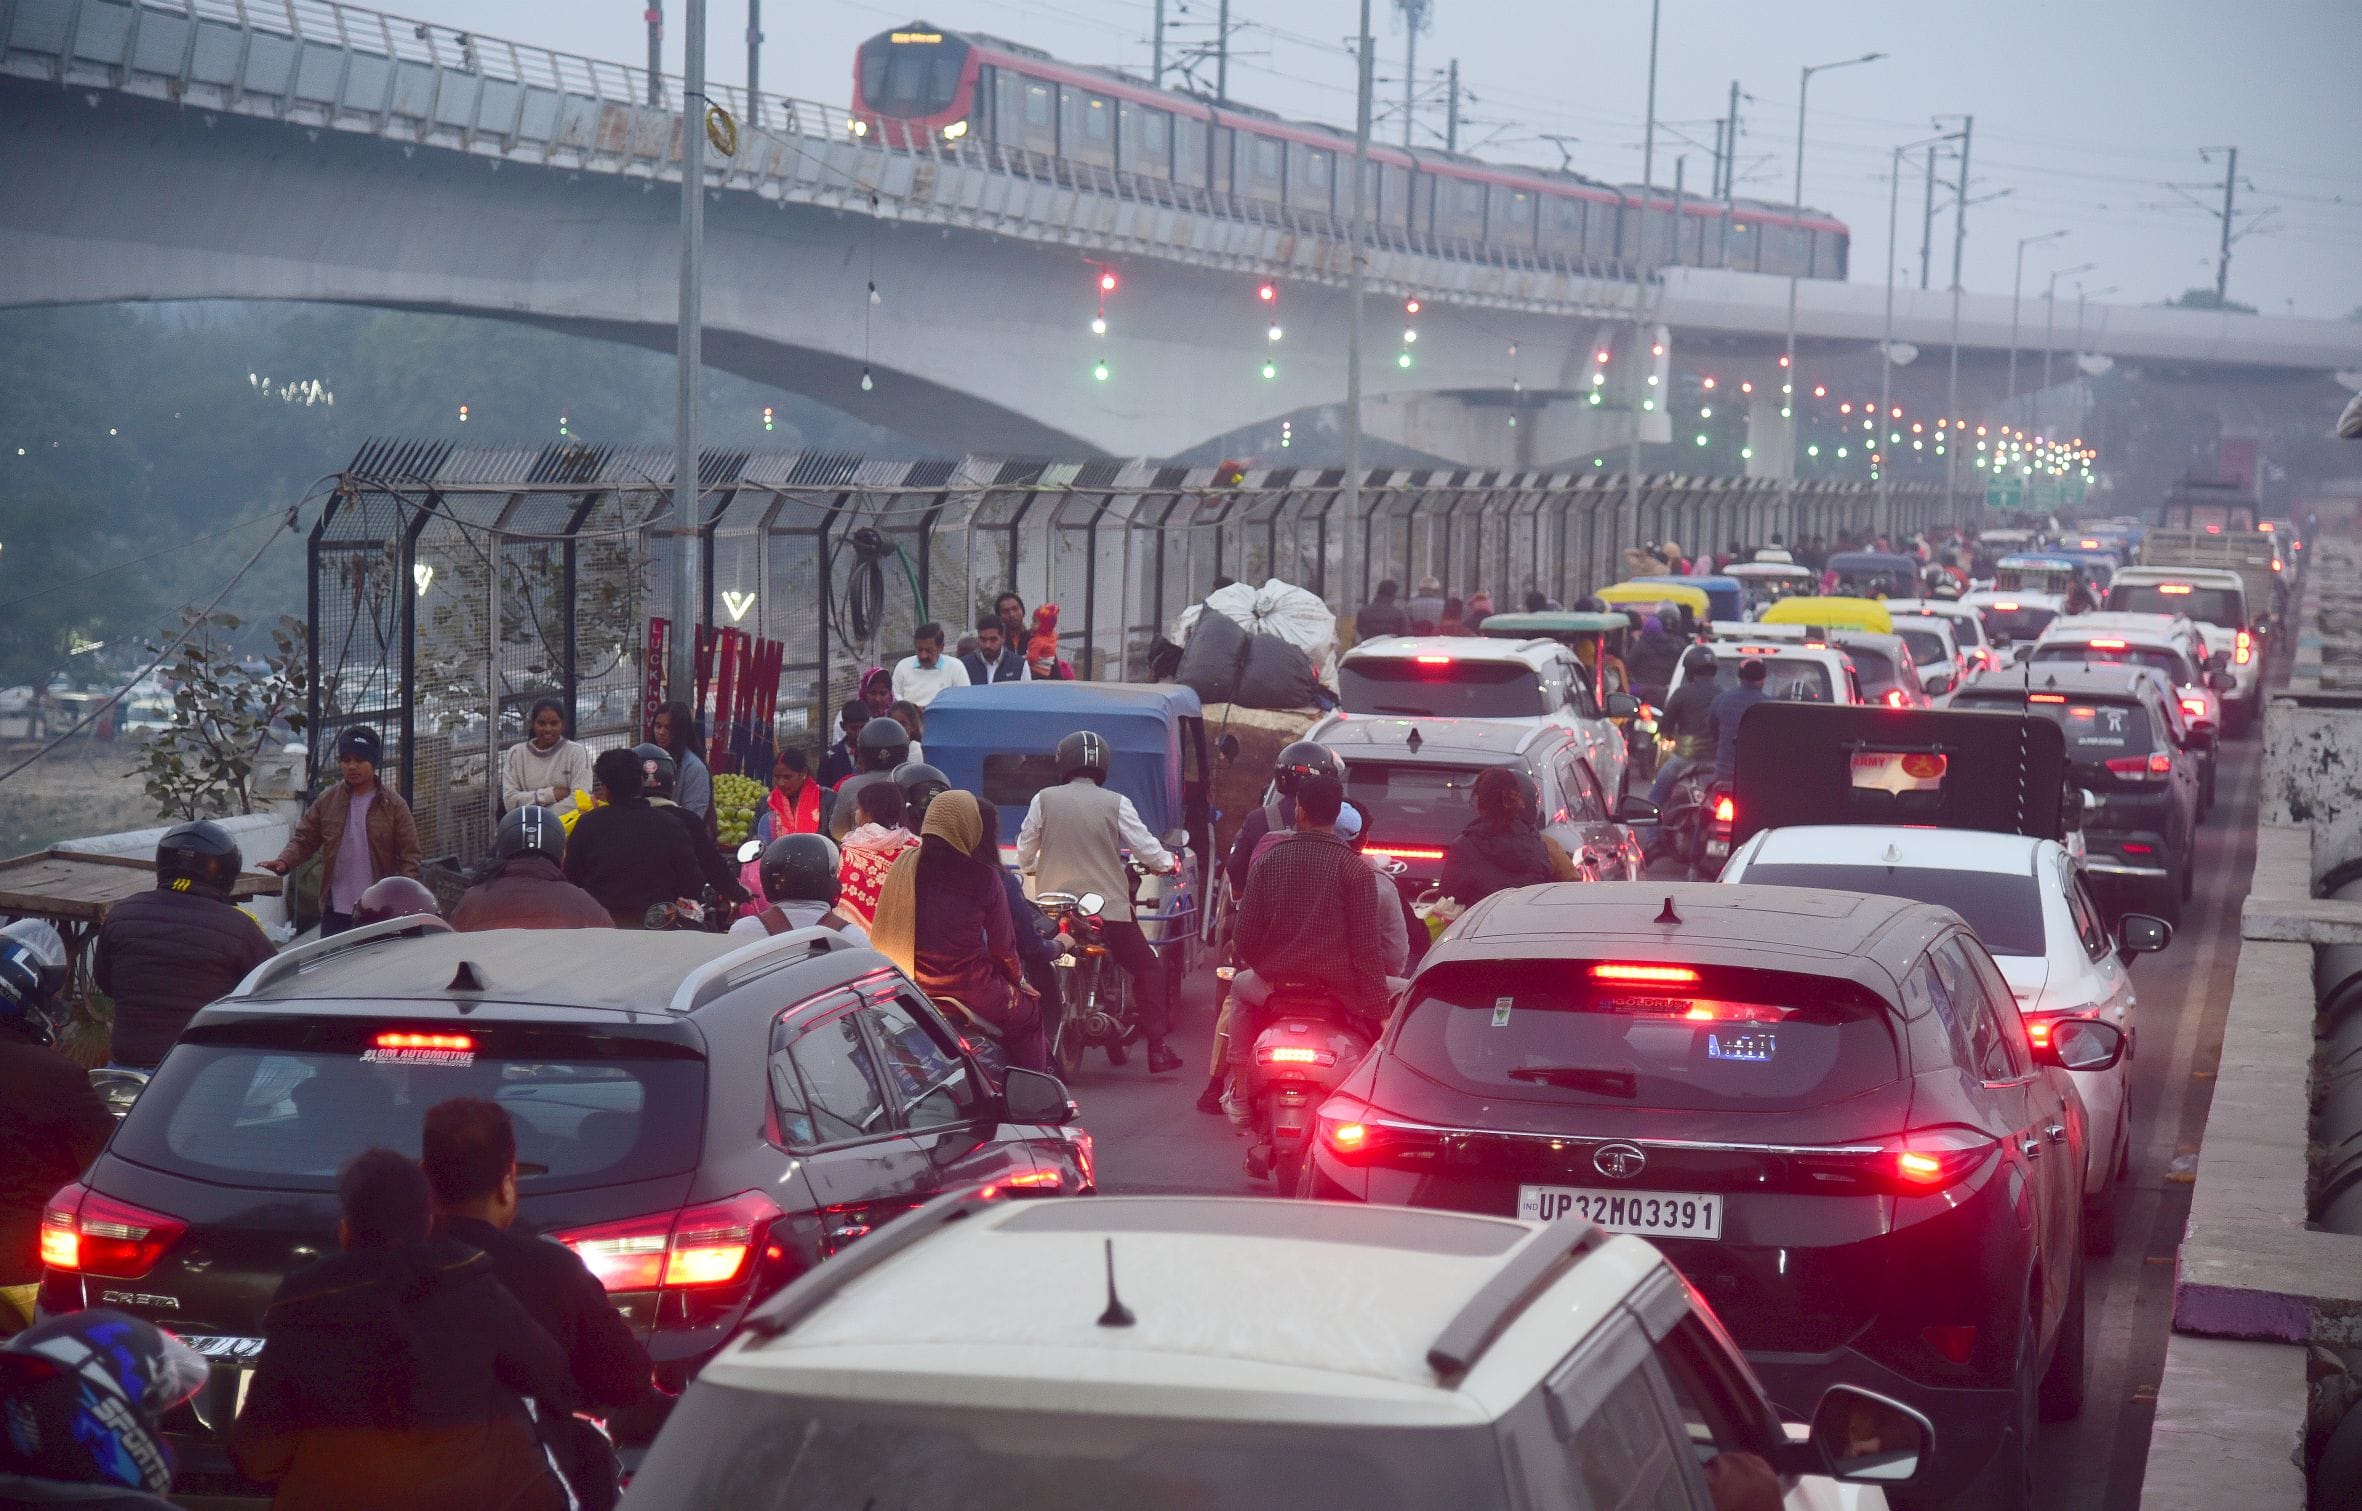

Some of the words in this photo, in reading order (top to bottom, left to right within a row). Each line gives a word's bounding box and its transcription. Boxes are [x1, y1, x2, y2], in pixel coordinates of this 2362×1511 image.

[1852, 756, 1886, 768] ARMY
[1615, 998, 1693, 1008] GOLDRUS
[400, 1049, 476, 1061] AUTOMOTIVE
[1523, 1202, 1538, 1211] IND
[1539, 1193, 1713, 1231] UP32MQ3391
[103, 1290, 180, 1309] CRETA
[91, 1397, 170, 1490] SPORTS
